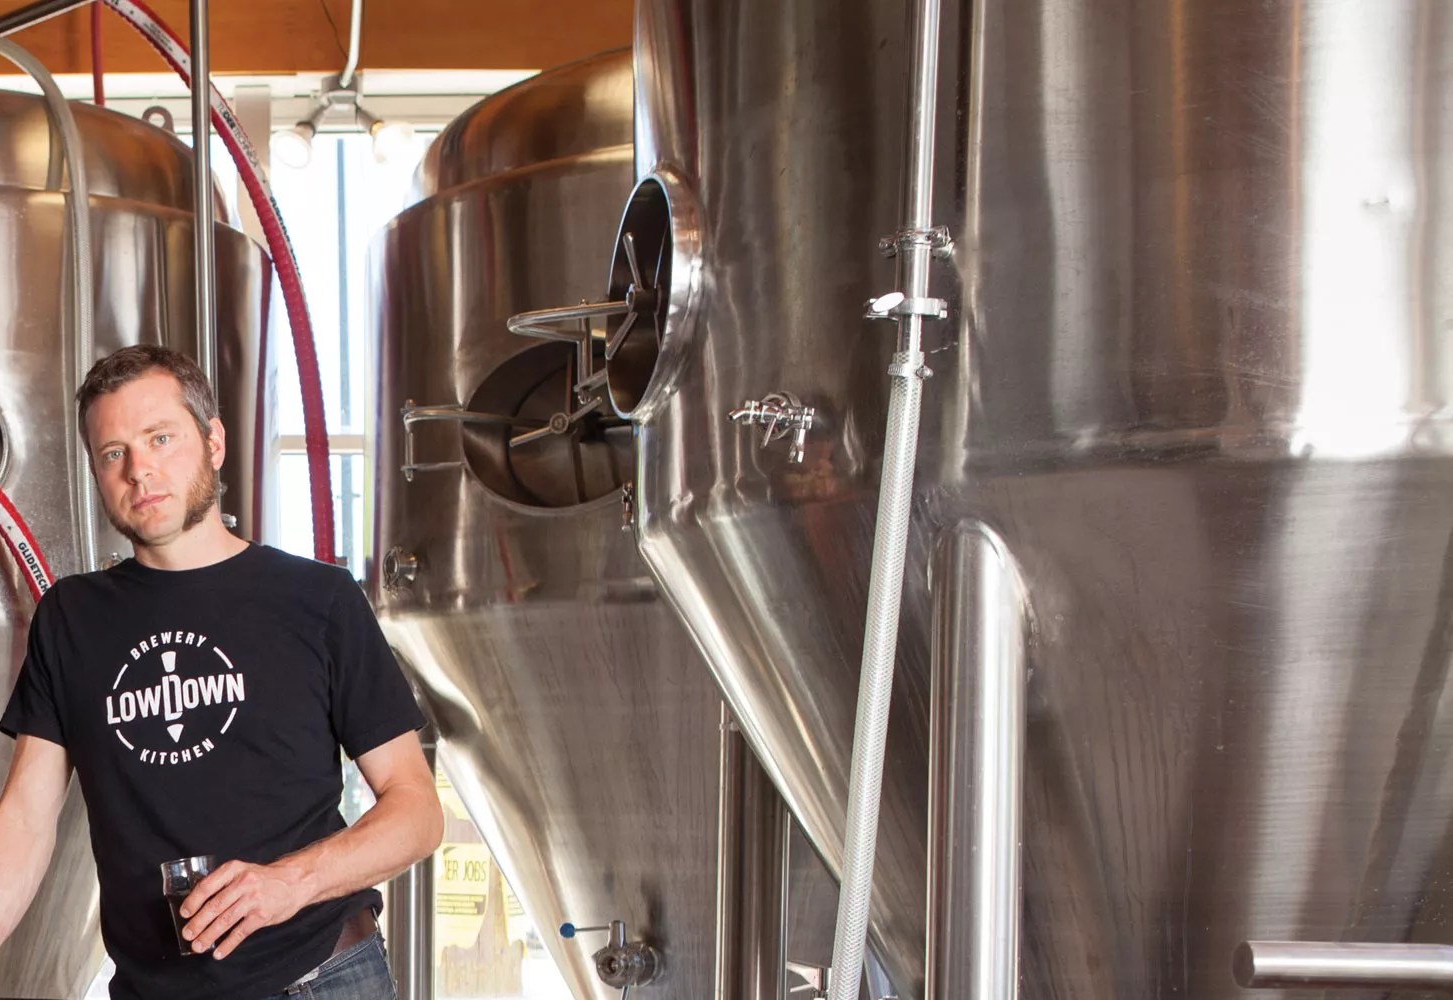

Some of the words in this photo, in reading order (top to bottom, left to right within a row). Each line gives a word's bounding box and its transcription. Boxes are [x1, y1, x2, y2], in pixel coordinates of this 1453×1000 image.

[130, 631, 208, 661] BREWERY
[139, 738, 215, 766] KITCHEN
[463, 860, 487, 882] JOBS
